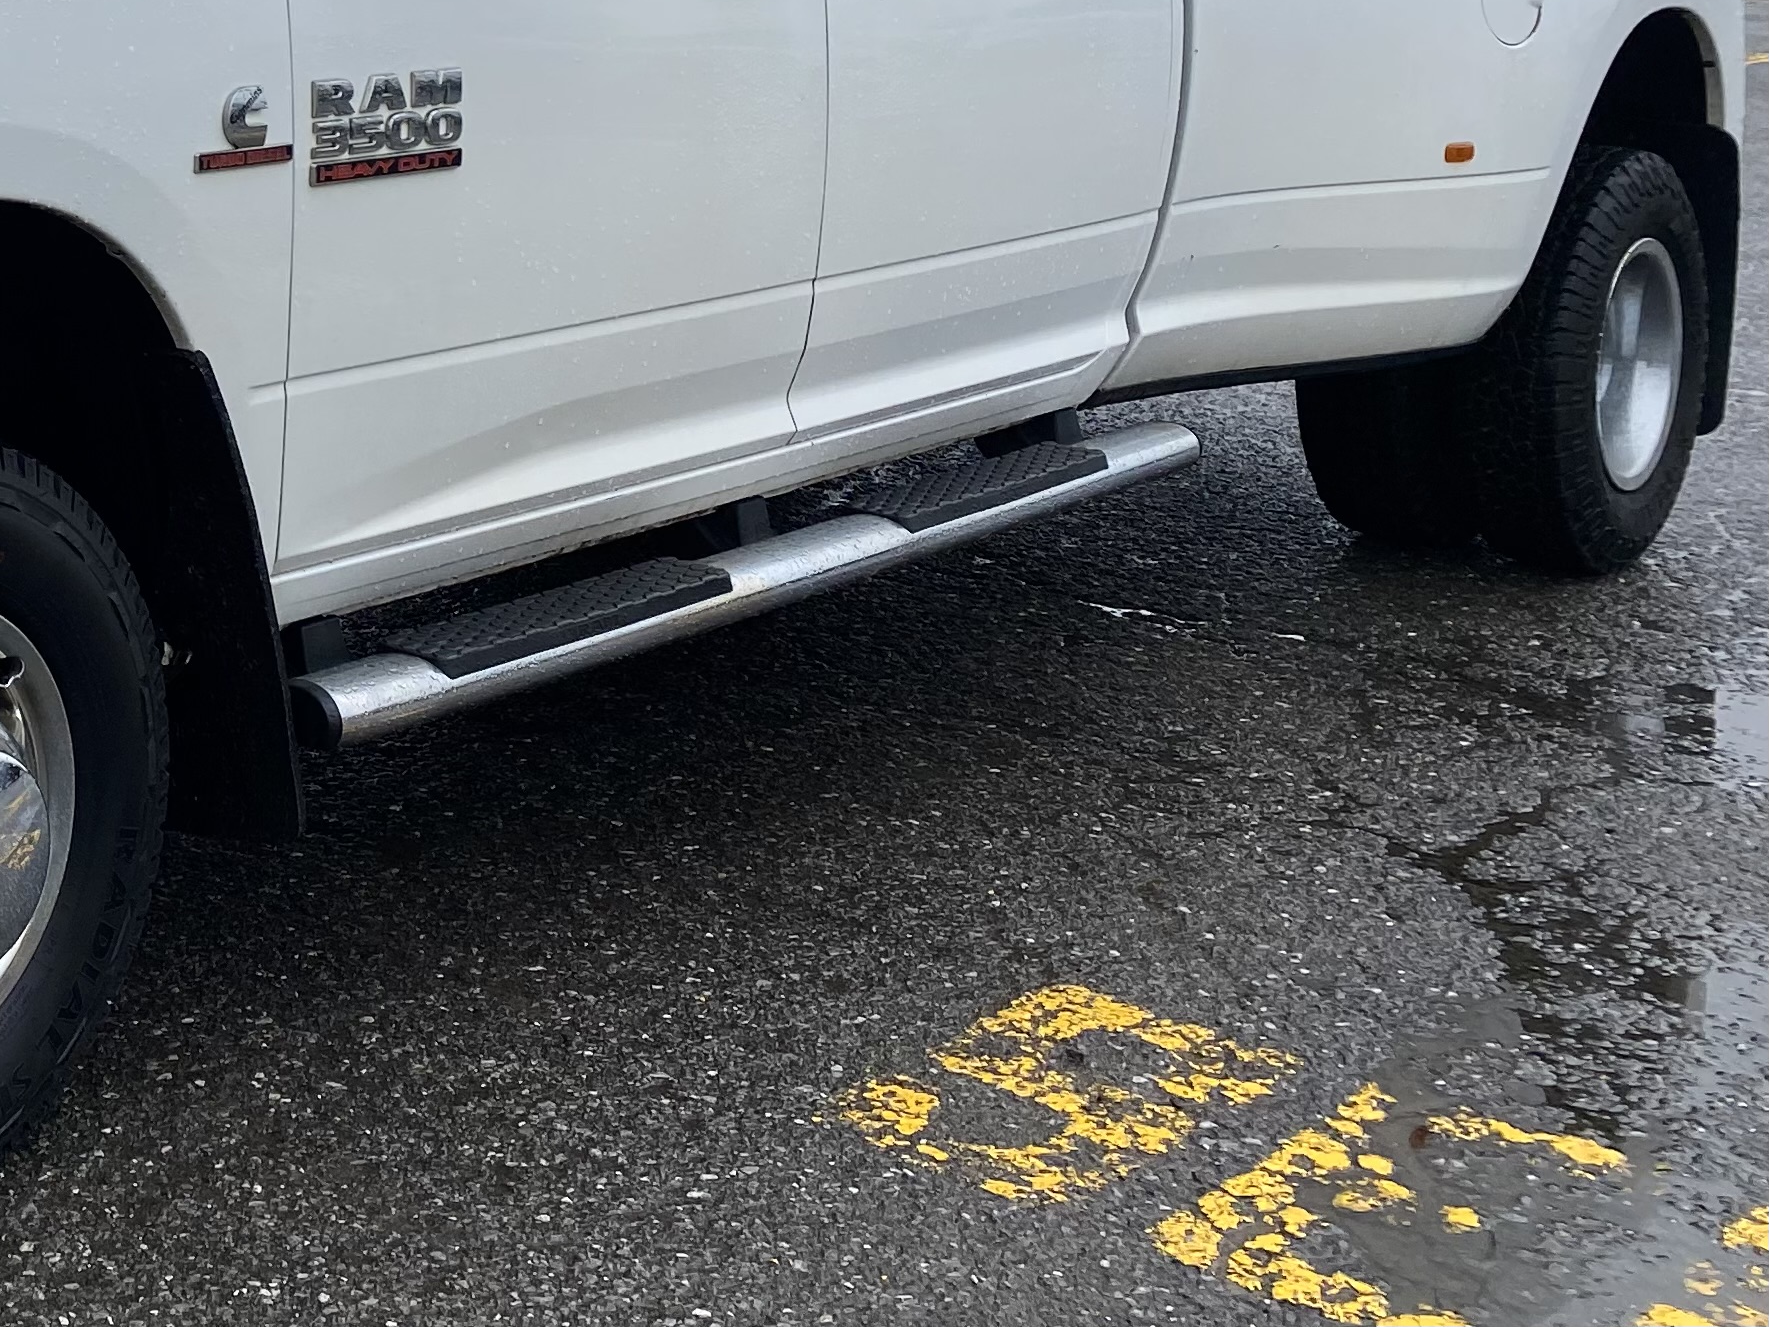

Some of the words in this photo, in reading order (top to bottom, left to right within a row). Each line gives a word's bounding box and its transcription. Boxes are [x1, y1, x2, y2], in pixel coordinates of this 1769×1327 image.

[311, 67, 463, 118] RAM
[310, 107, 463, 160] 3500
[319, 157, 392, 182] HEAVY
[397, 150, 459, 173] DUTY
[35, 825, 141, 1058] RADIAL
